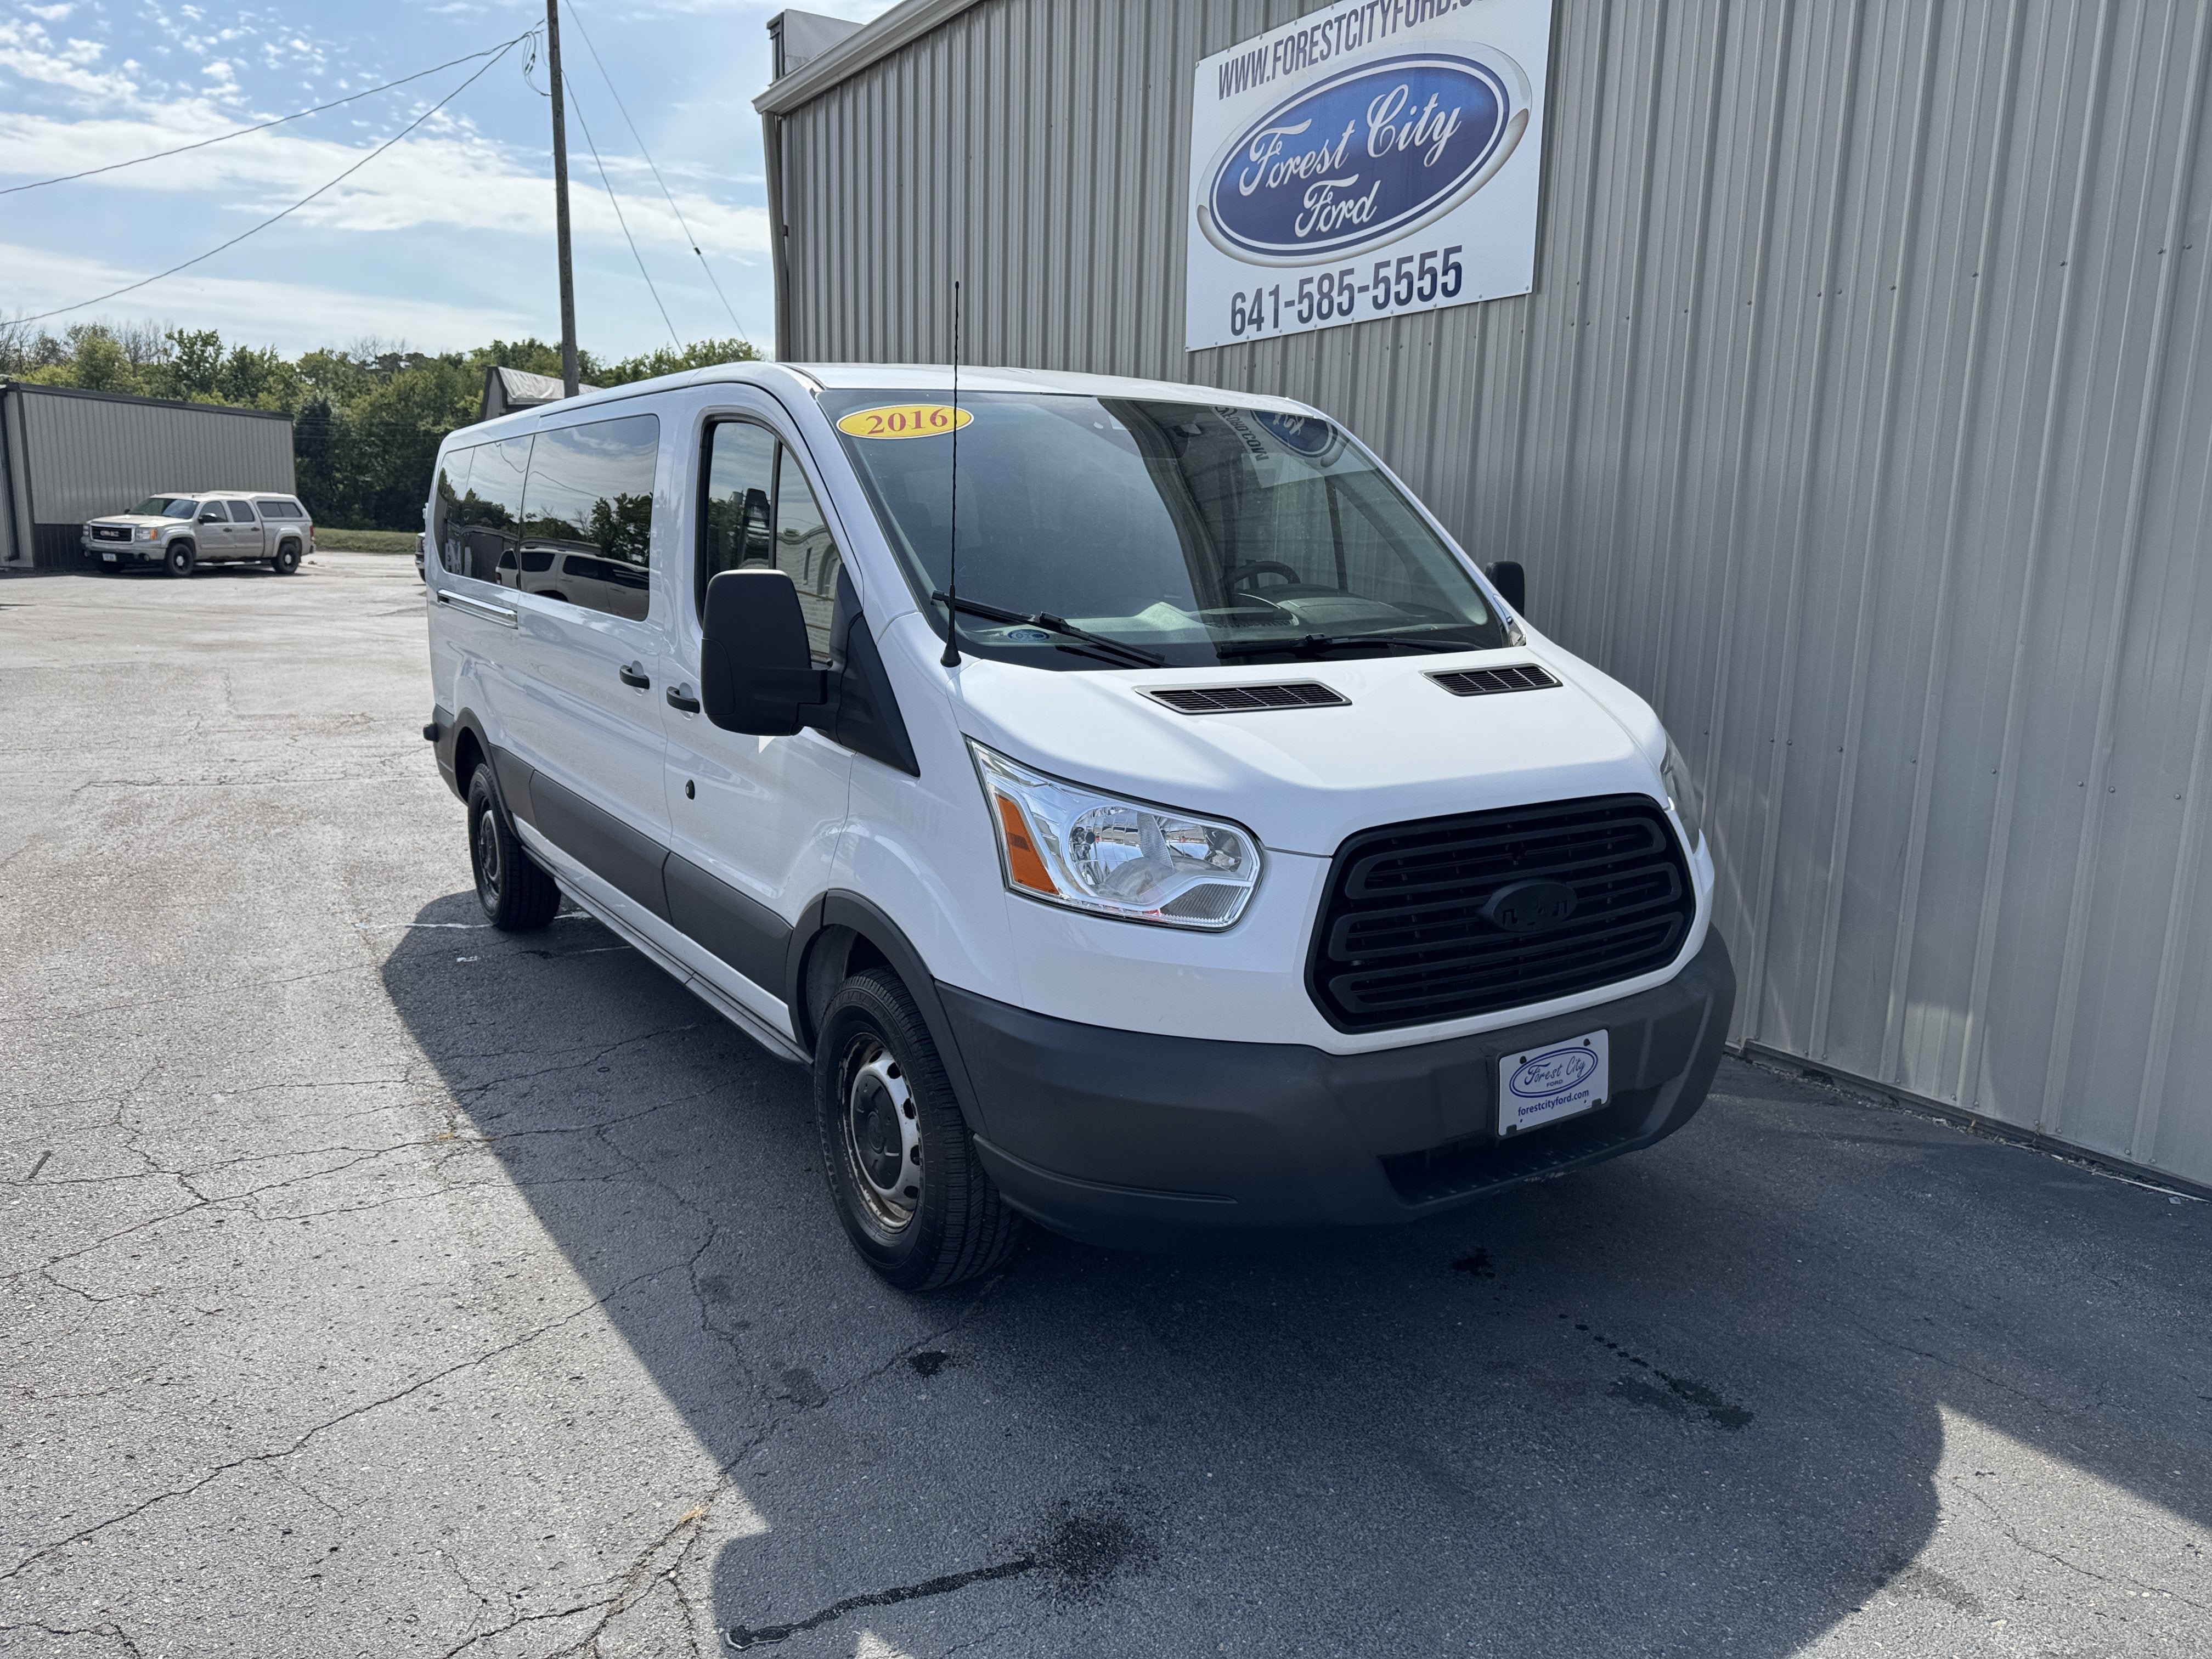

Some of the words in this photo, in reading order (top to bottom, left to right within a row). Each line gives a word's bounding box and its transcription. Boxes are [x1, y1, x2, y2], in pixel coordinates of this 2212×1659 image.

[1239, 119, 1356, 197] Forest
[1367, 84, 1462, 168] City
[1294, 173, 1381, 238] Ford
[1231, 245, 1463, 336] 641-585-5555
[866, 408, 948, 435] 2016
[1524, 1062, 1562, 1085] Forest
[1566, 1056, 1585, 1077] City
[1547, 1079, 1563, 1087] FORD
[1518, 1090, 1589, 1116] forestcityford.com
